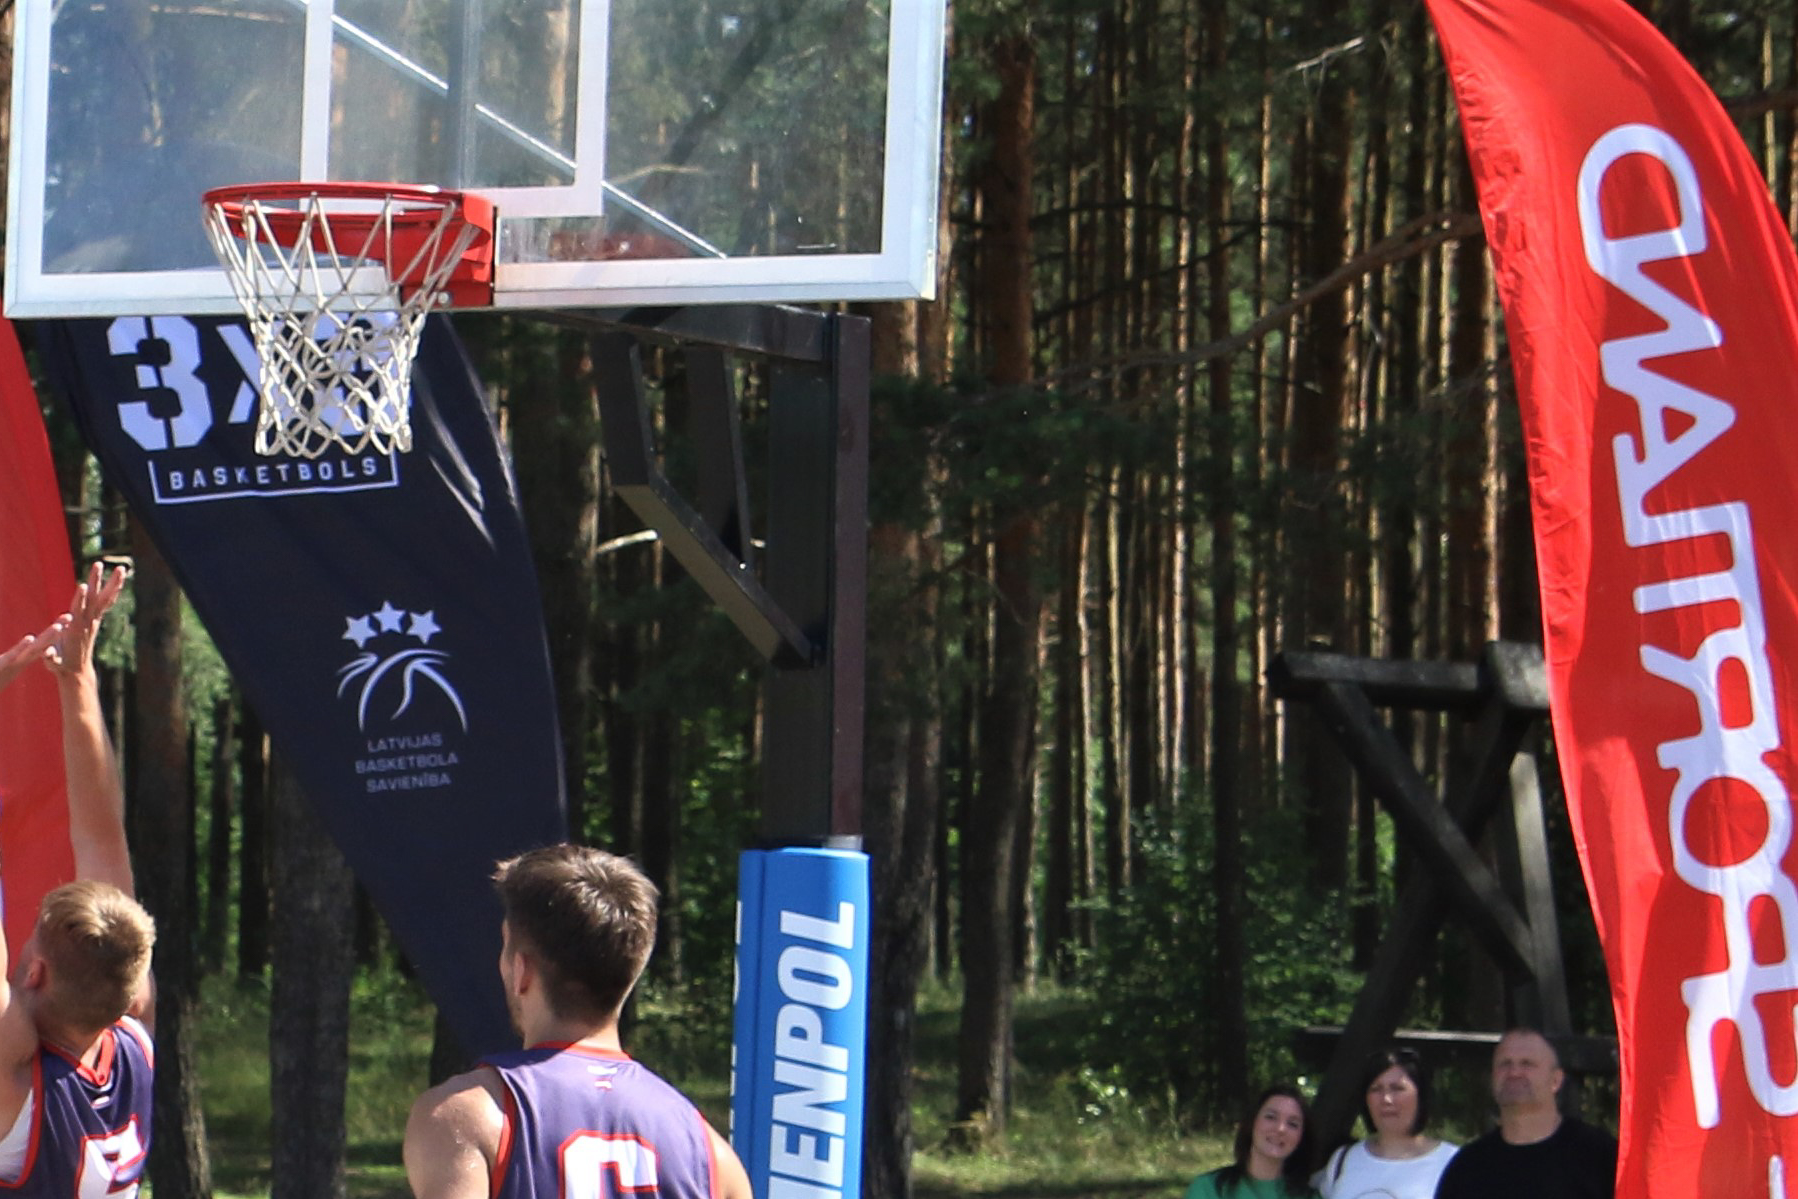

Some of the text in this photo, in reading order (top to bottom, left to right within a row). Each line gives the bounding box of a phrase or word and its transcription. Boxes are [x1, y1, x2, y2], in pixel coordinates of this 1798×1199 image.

[169, 456, 378, 490] BASKETBOLS
[367, 732, 442, 753] LATVIJAS
[355, 752, 458, 774] BASKETBOLA
